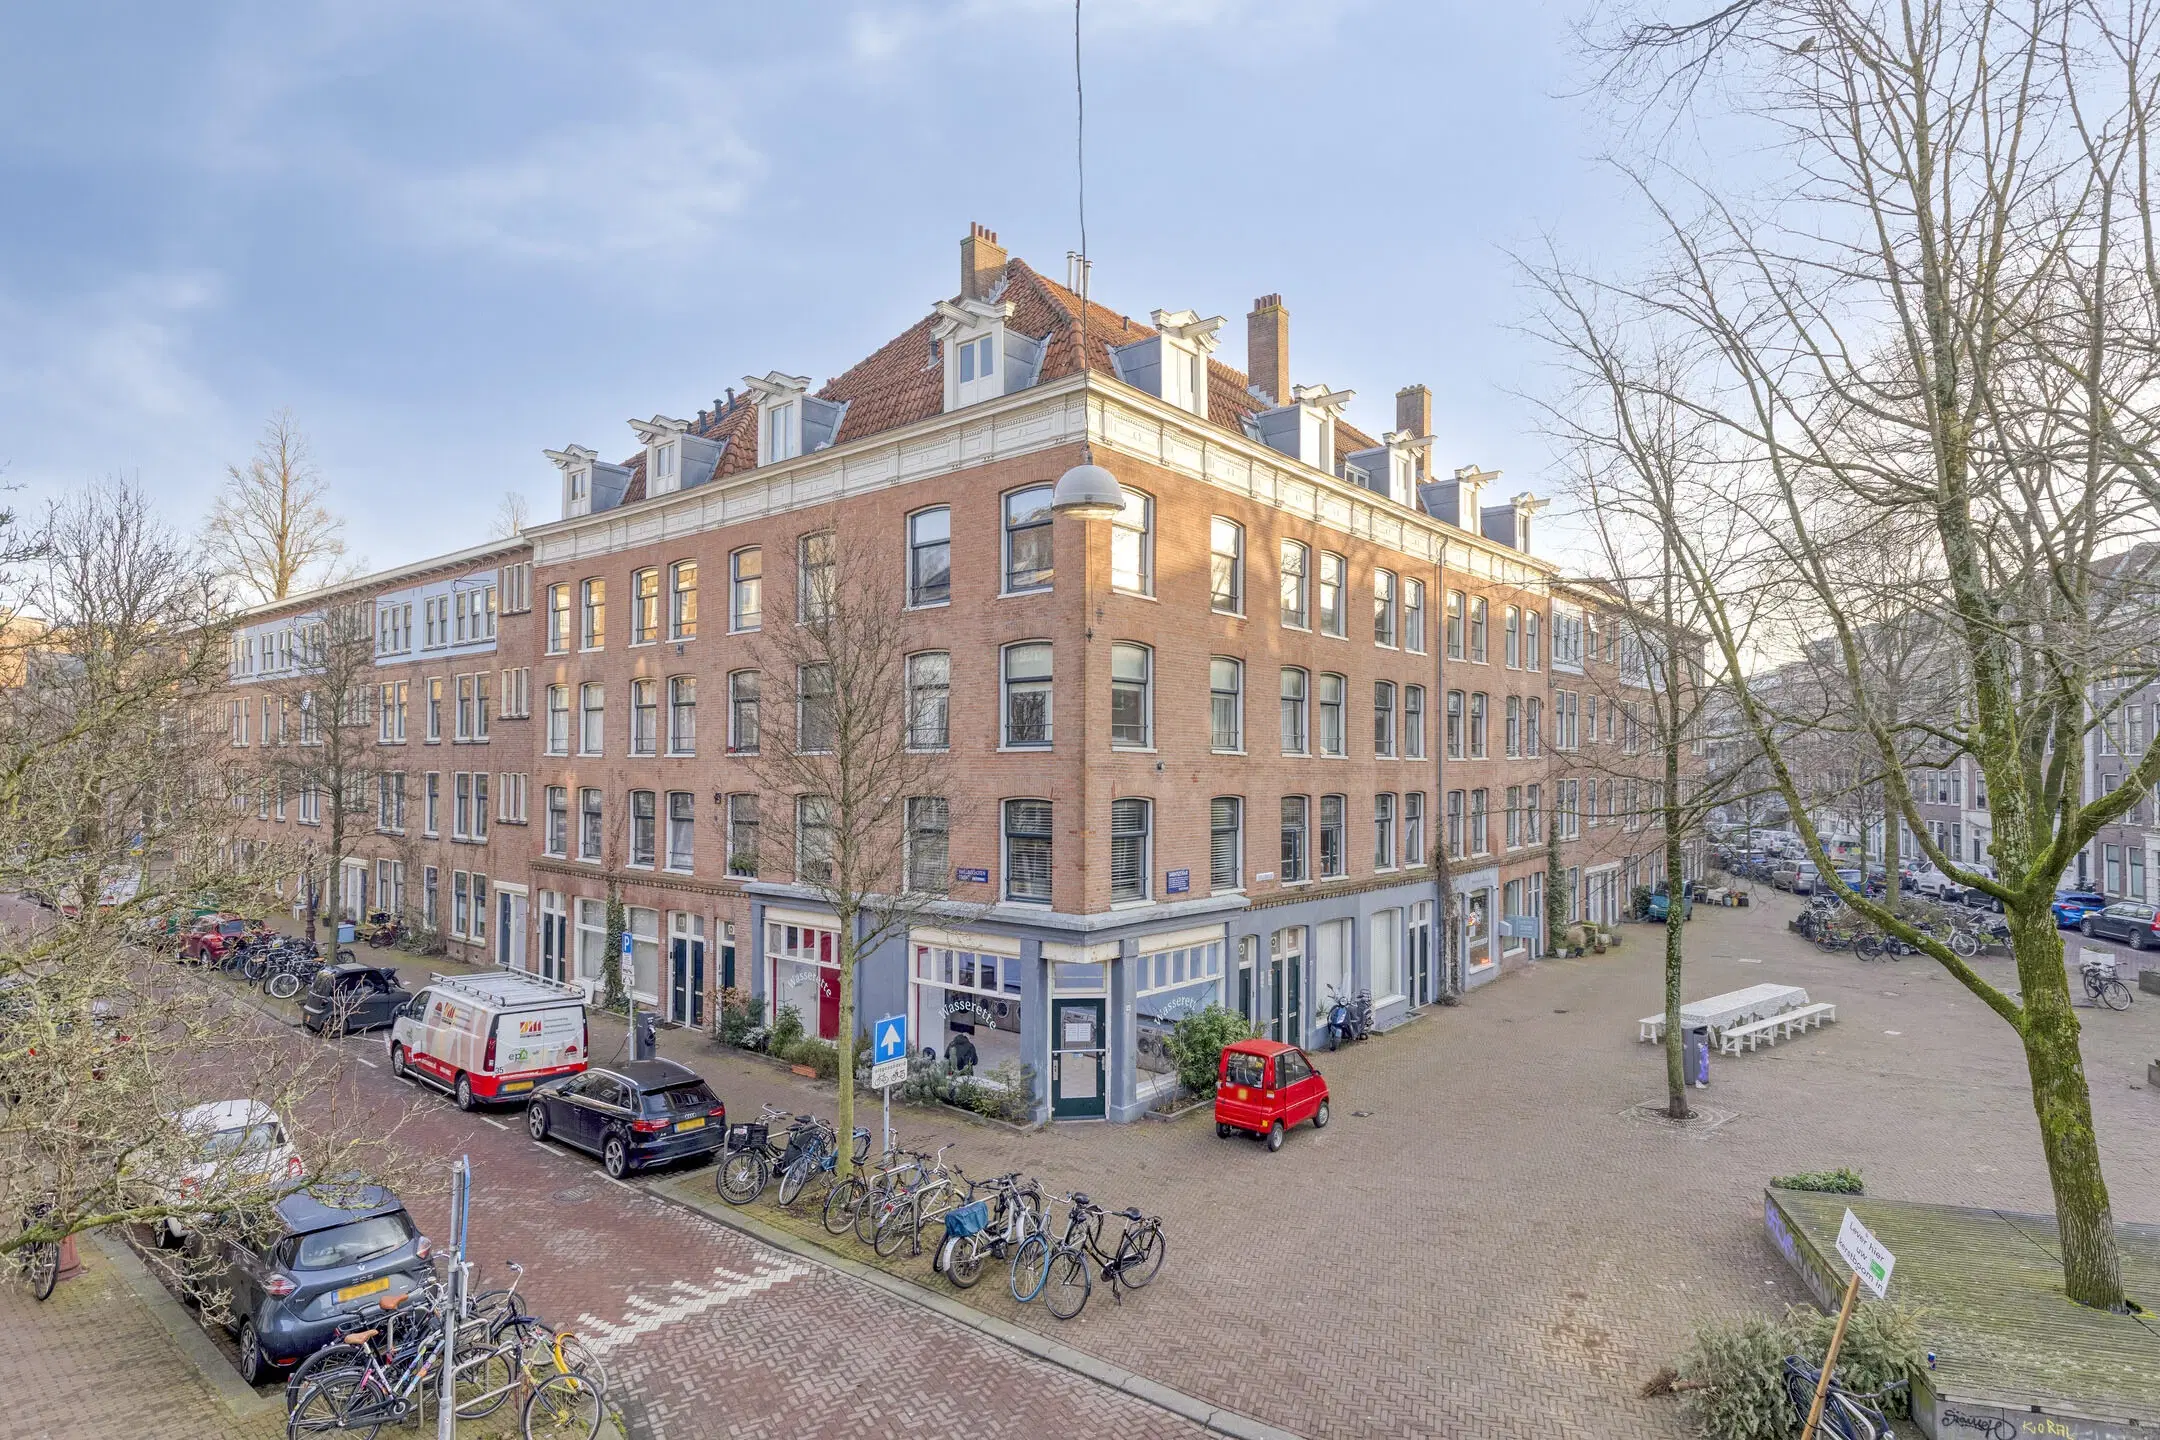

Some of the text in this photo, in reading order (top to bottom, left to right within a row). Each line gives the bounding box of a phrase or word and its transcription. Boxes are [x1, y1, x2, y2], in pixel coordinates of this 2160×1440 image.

[788, 971, 831, 998] Wasserette
[938, 1000, 997, 1031] Wasserette
[1849, 1222, 1884, 1261] Lever hier
[1856, 1247, 1868, 1260] uw
[1839, 1238, 1874, 1281] kerstboom
[1875, 1281, 1883, 1292] in
